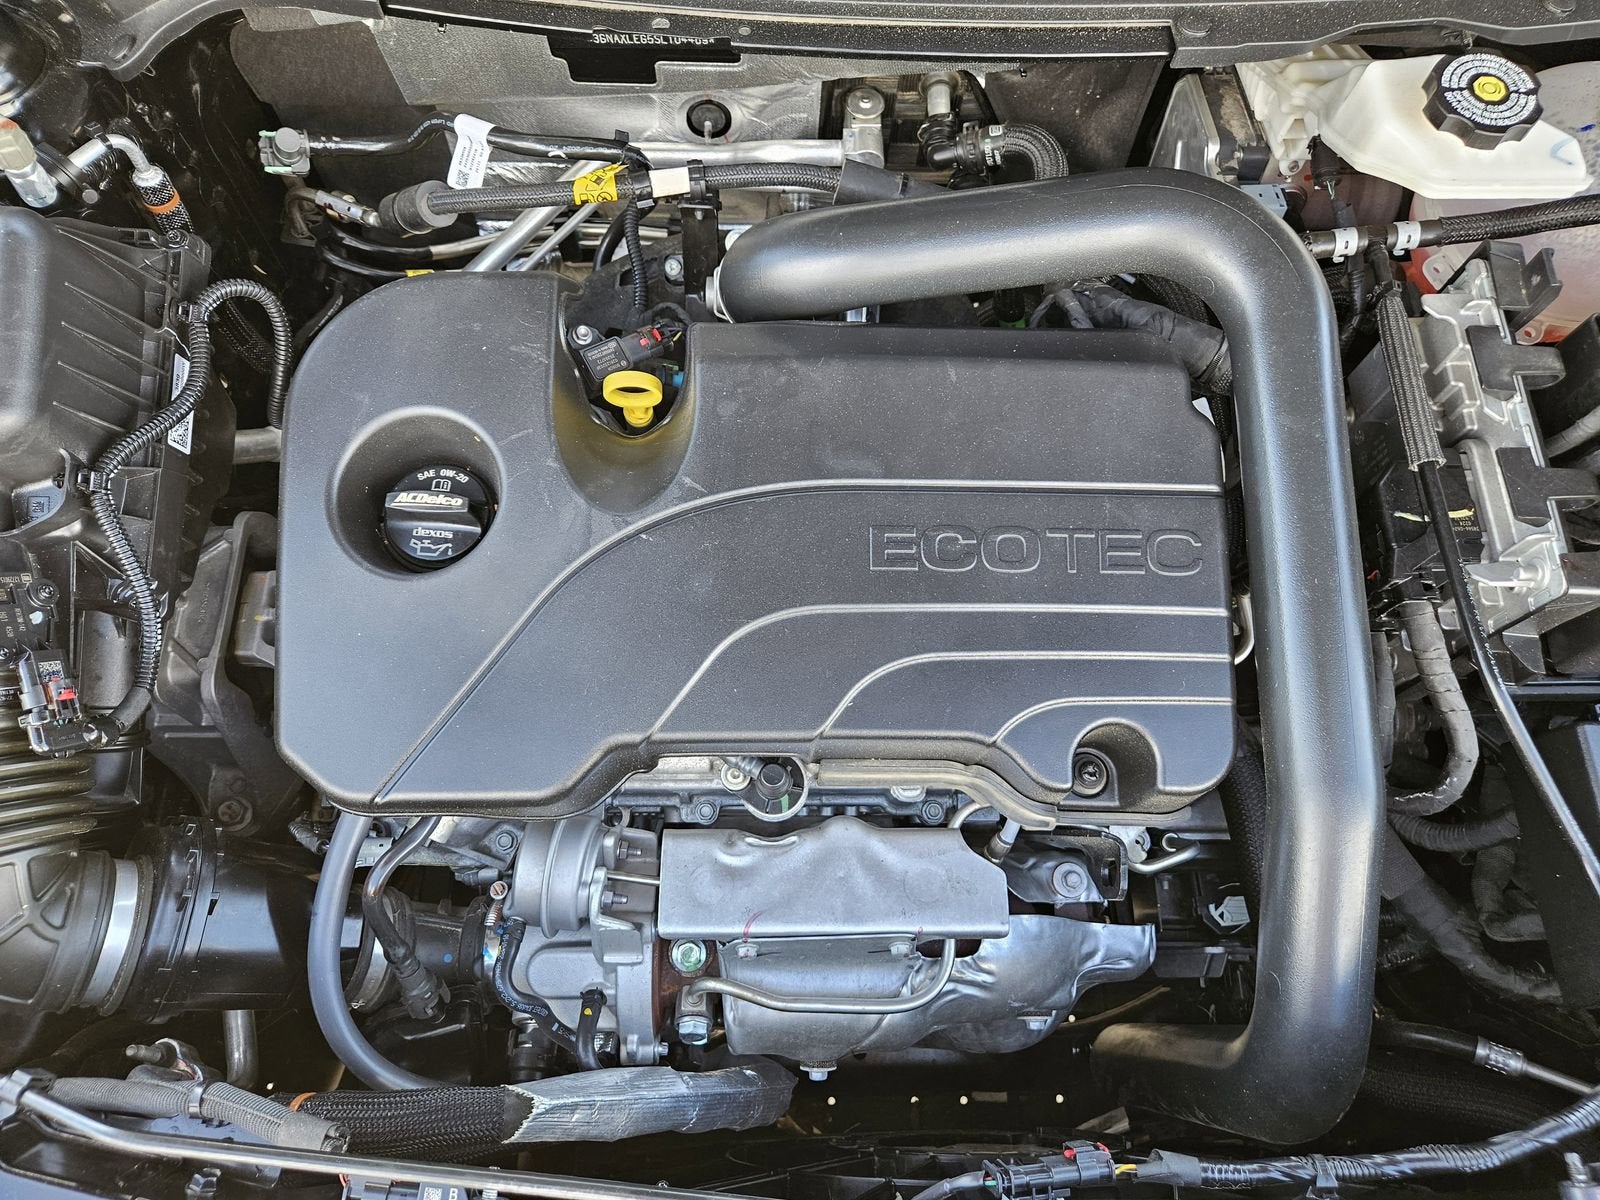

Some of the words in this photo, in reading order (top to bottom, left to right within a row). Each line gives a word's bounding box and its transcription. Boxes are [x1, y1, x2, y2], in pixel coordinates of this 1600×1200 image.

[417, 469, 436, 481] SAE
[440, 469, 469, 484] 0W-20
[393, 492, 463, 506] ACDelco
[412, 527, 453, 539] dexos
[869, 524, 1202, 576] ECOTEC
